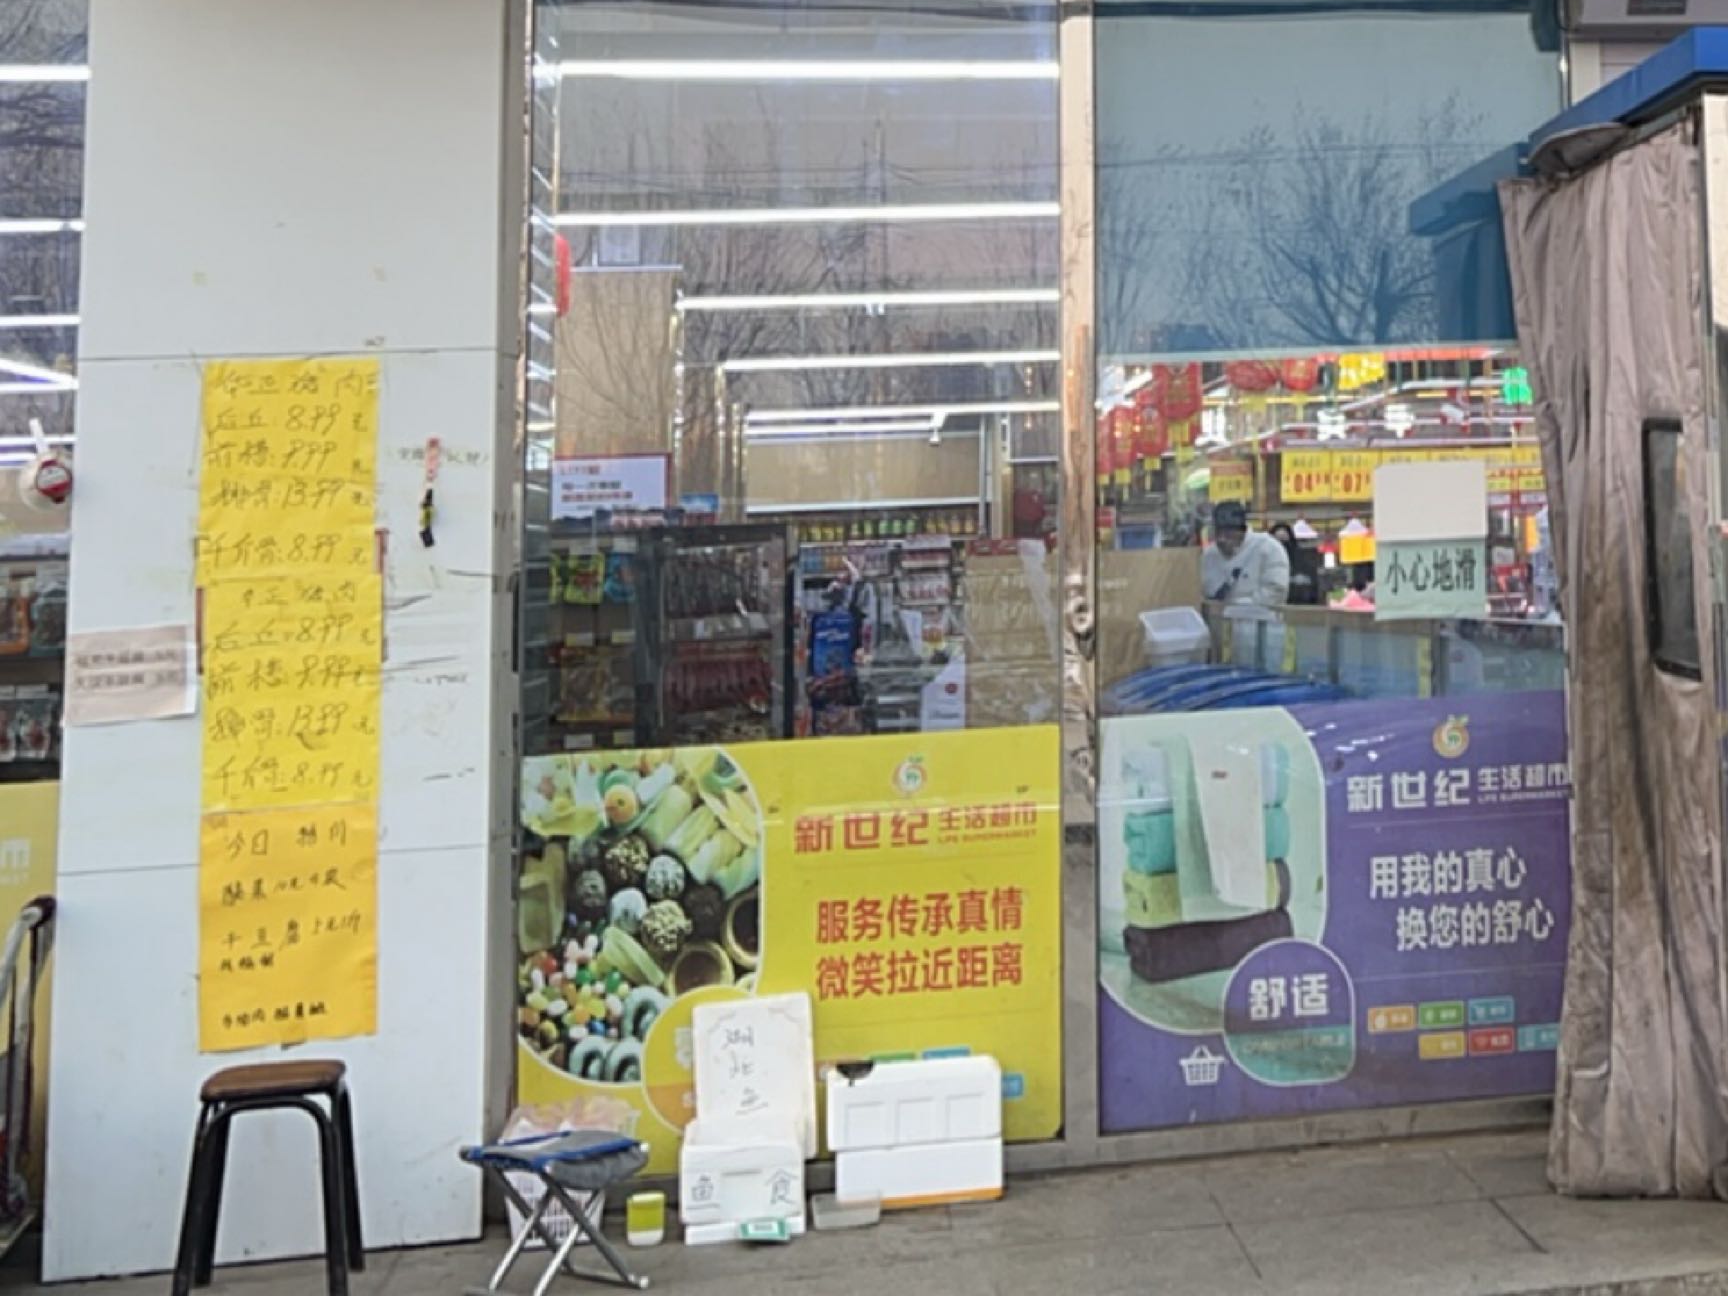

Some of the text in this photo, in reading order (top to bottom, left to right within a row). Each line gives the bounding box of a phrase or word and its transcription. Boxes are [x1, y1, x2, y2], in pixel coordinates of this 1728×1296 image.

[1385, 547, 1477, 594] 小心地滑
[1346, 763, 1568, 813] 新世纪 生活超市
[794, 800, 1037, 855] 新世纪 生活超市
[1368, 847, 1527, 901] 用我的真心
[815, 885, 1023, 945] 服务传承真情
[1396, 898, 1555, 952] 换您的舒心
[815, 942, 1023, 1002] 微笑拉近距离
[1248, 973, 1330, 1022] 舒适
